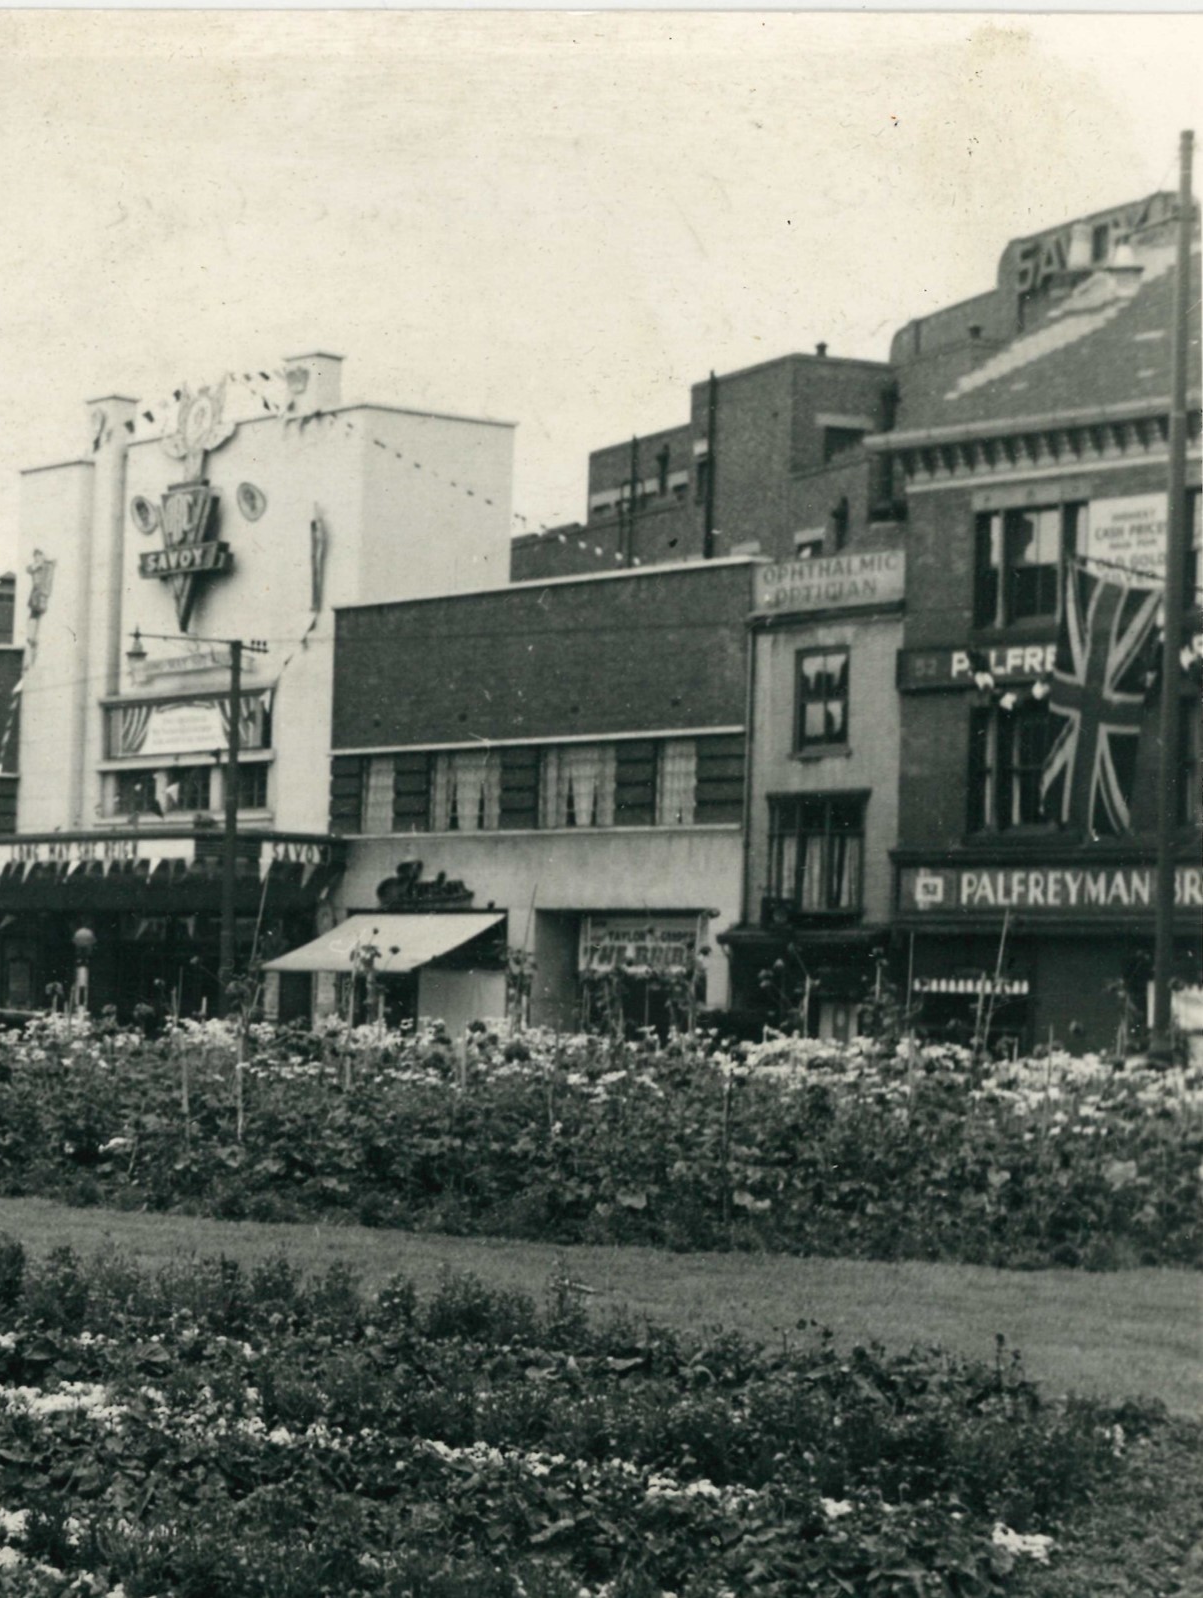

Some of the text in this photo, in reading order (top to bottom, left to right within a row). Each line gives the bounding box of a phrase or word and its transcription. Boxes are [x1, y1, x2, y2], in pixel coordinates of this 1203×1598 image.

[145, 547, 203, 573] SAVOY
[763, 554, 897, 585] OPHTHALMIC
[772, 578, 878, 607] OPTICIAN
[951, 644, 1058, 678] PLFRE
[10, 844, 38, 862] LONG
[48, 843, 70, 861] MAY
[77, 842, 96, 860] SHE
[103, 841, 137, 860] REIGN
[961, 869, 1151, 906] PALFREYMAN
